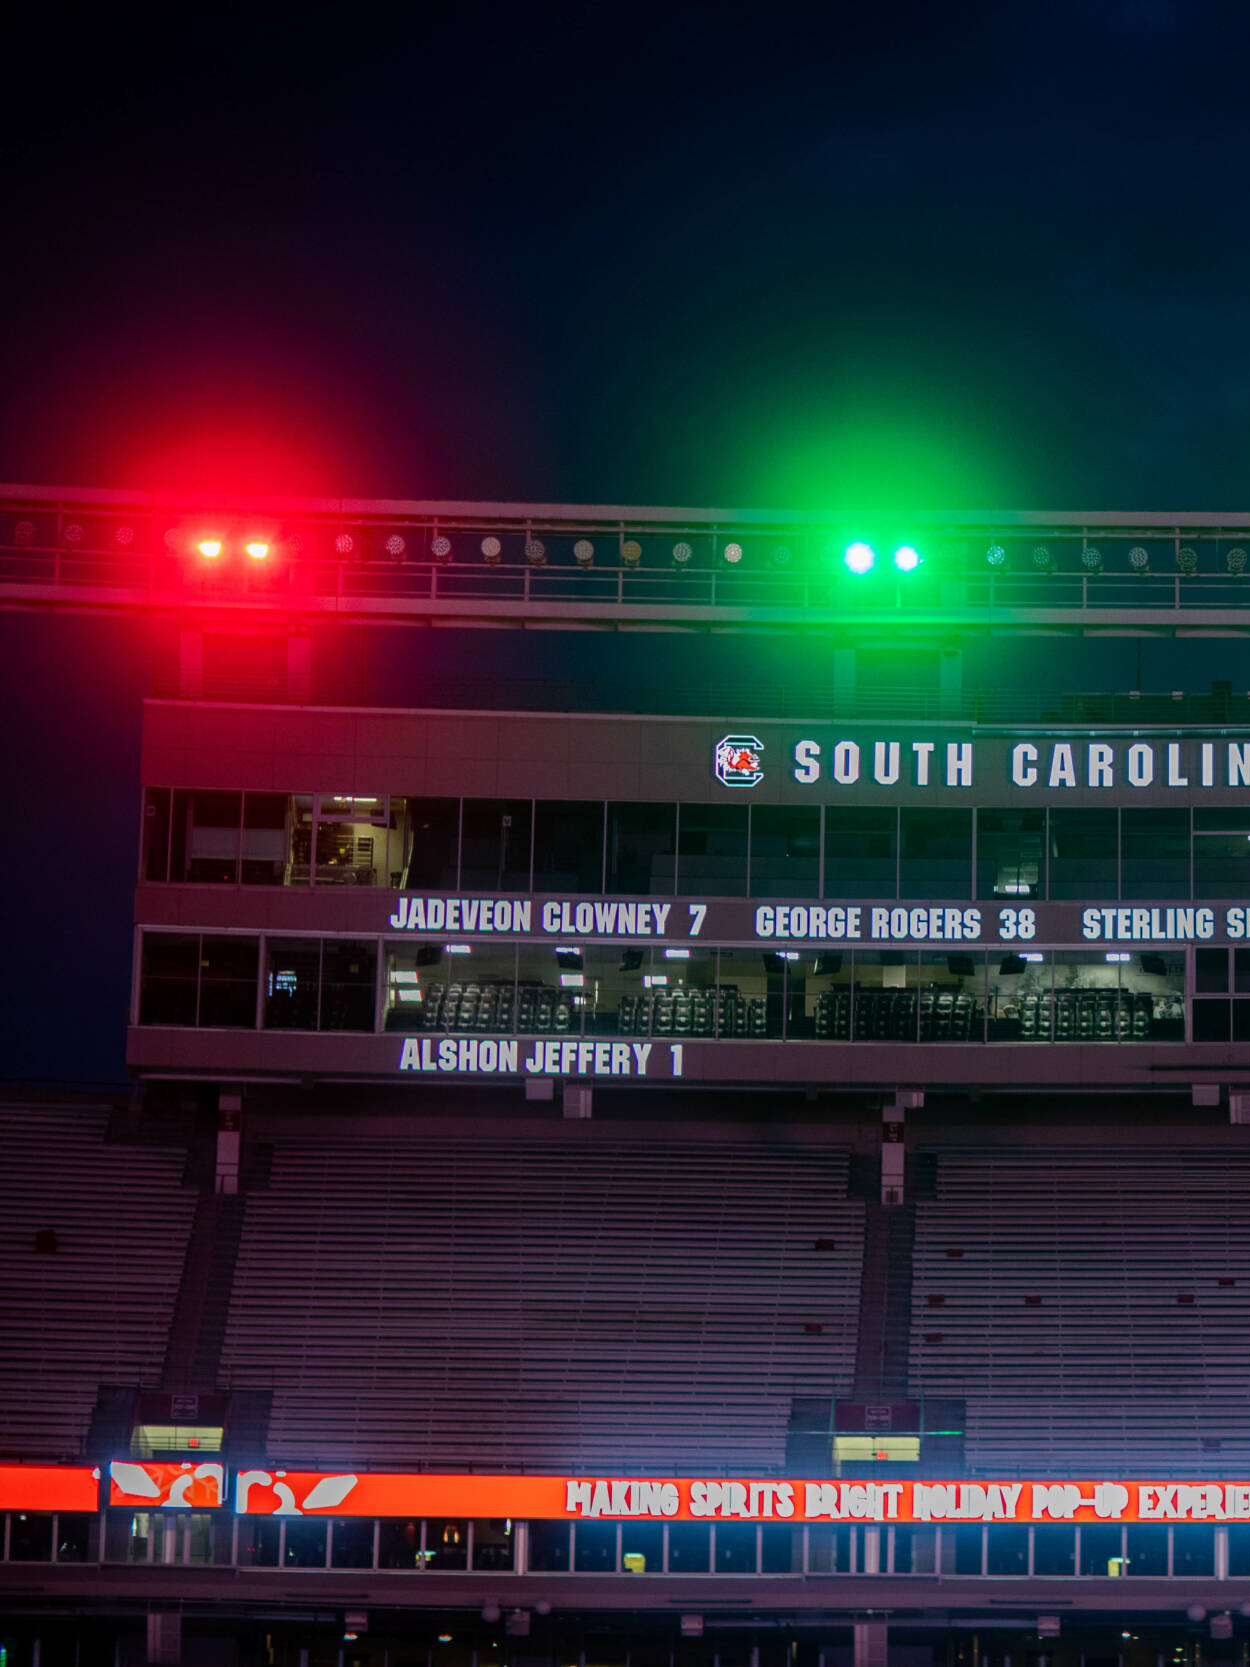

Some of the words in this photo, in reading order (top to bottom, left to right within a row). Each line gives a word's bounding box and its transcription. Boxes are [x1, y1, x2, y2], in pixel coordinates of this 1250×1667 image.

[793, 739, 973, 787] SOUTH
[389, 897, 532, 932] JADEVEON
[542, 901, 672, 935] CLOWNEY
[688, 903, 708, 936] 7
[755, 905, 862, 939] GEORGE
[870, 907, 982, 940] ROGERS
[998, 907, 1037, 940] 38
[1082, 907, 1214, 940] STERLING
[399, 1037, 519, 1073] ALSHON
[524, 1041, 653, 1075] JEFFERY
[670, 1043, 684, 1076] 1
[565, 1479, 680, 1519] MAKING
[688, 1480, 796, 1519] SPIRITS
[803, 1481, 905, 1522] BRIGHT
[911, 1481, 1024, 1523] HOLIDAY
[1030, 1481, 1130, 1520] POP-UP
